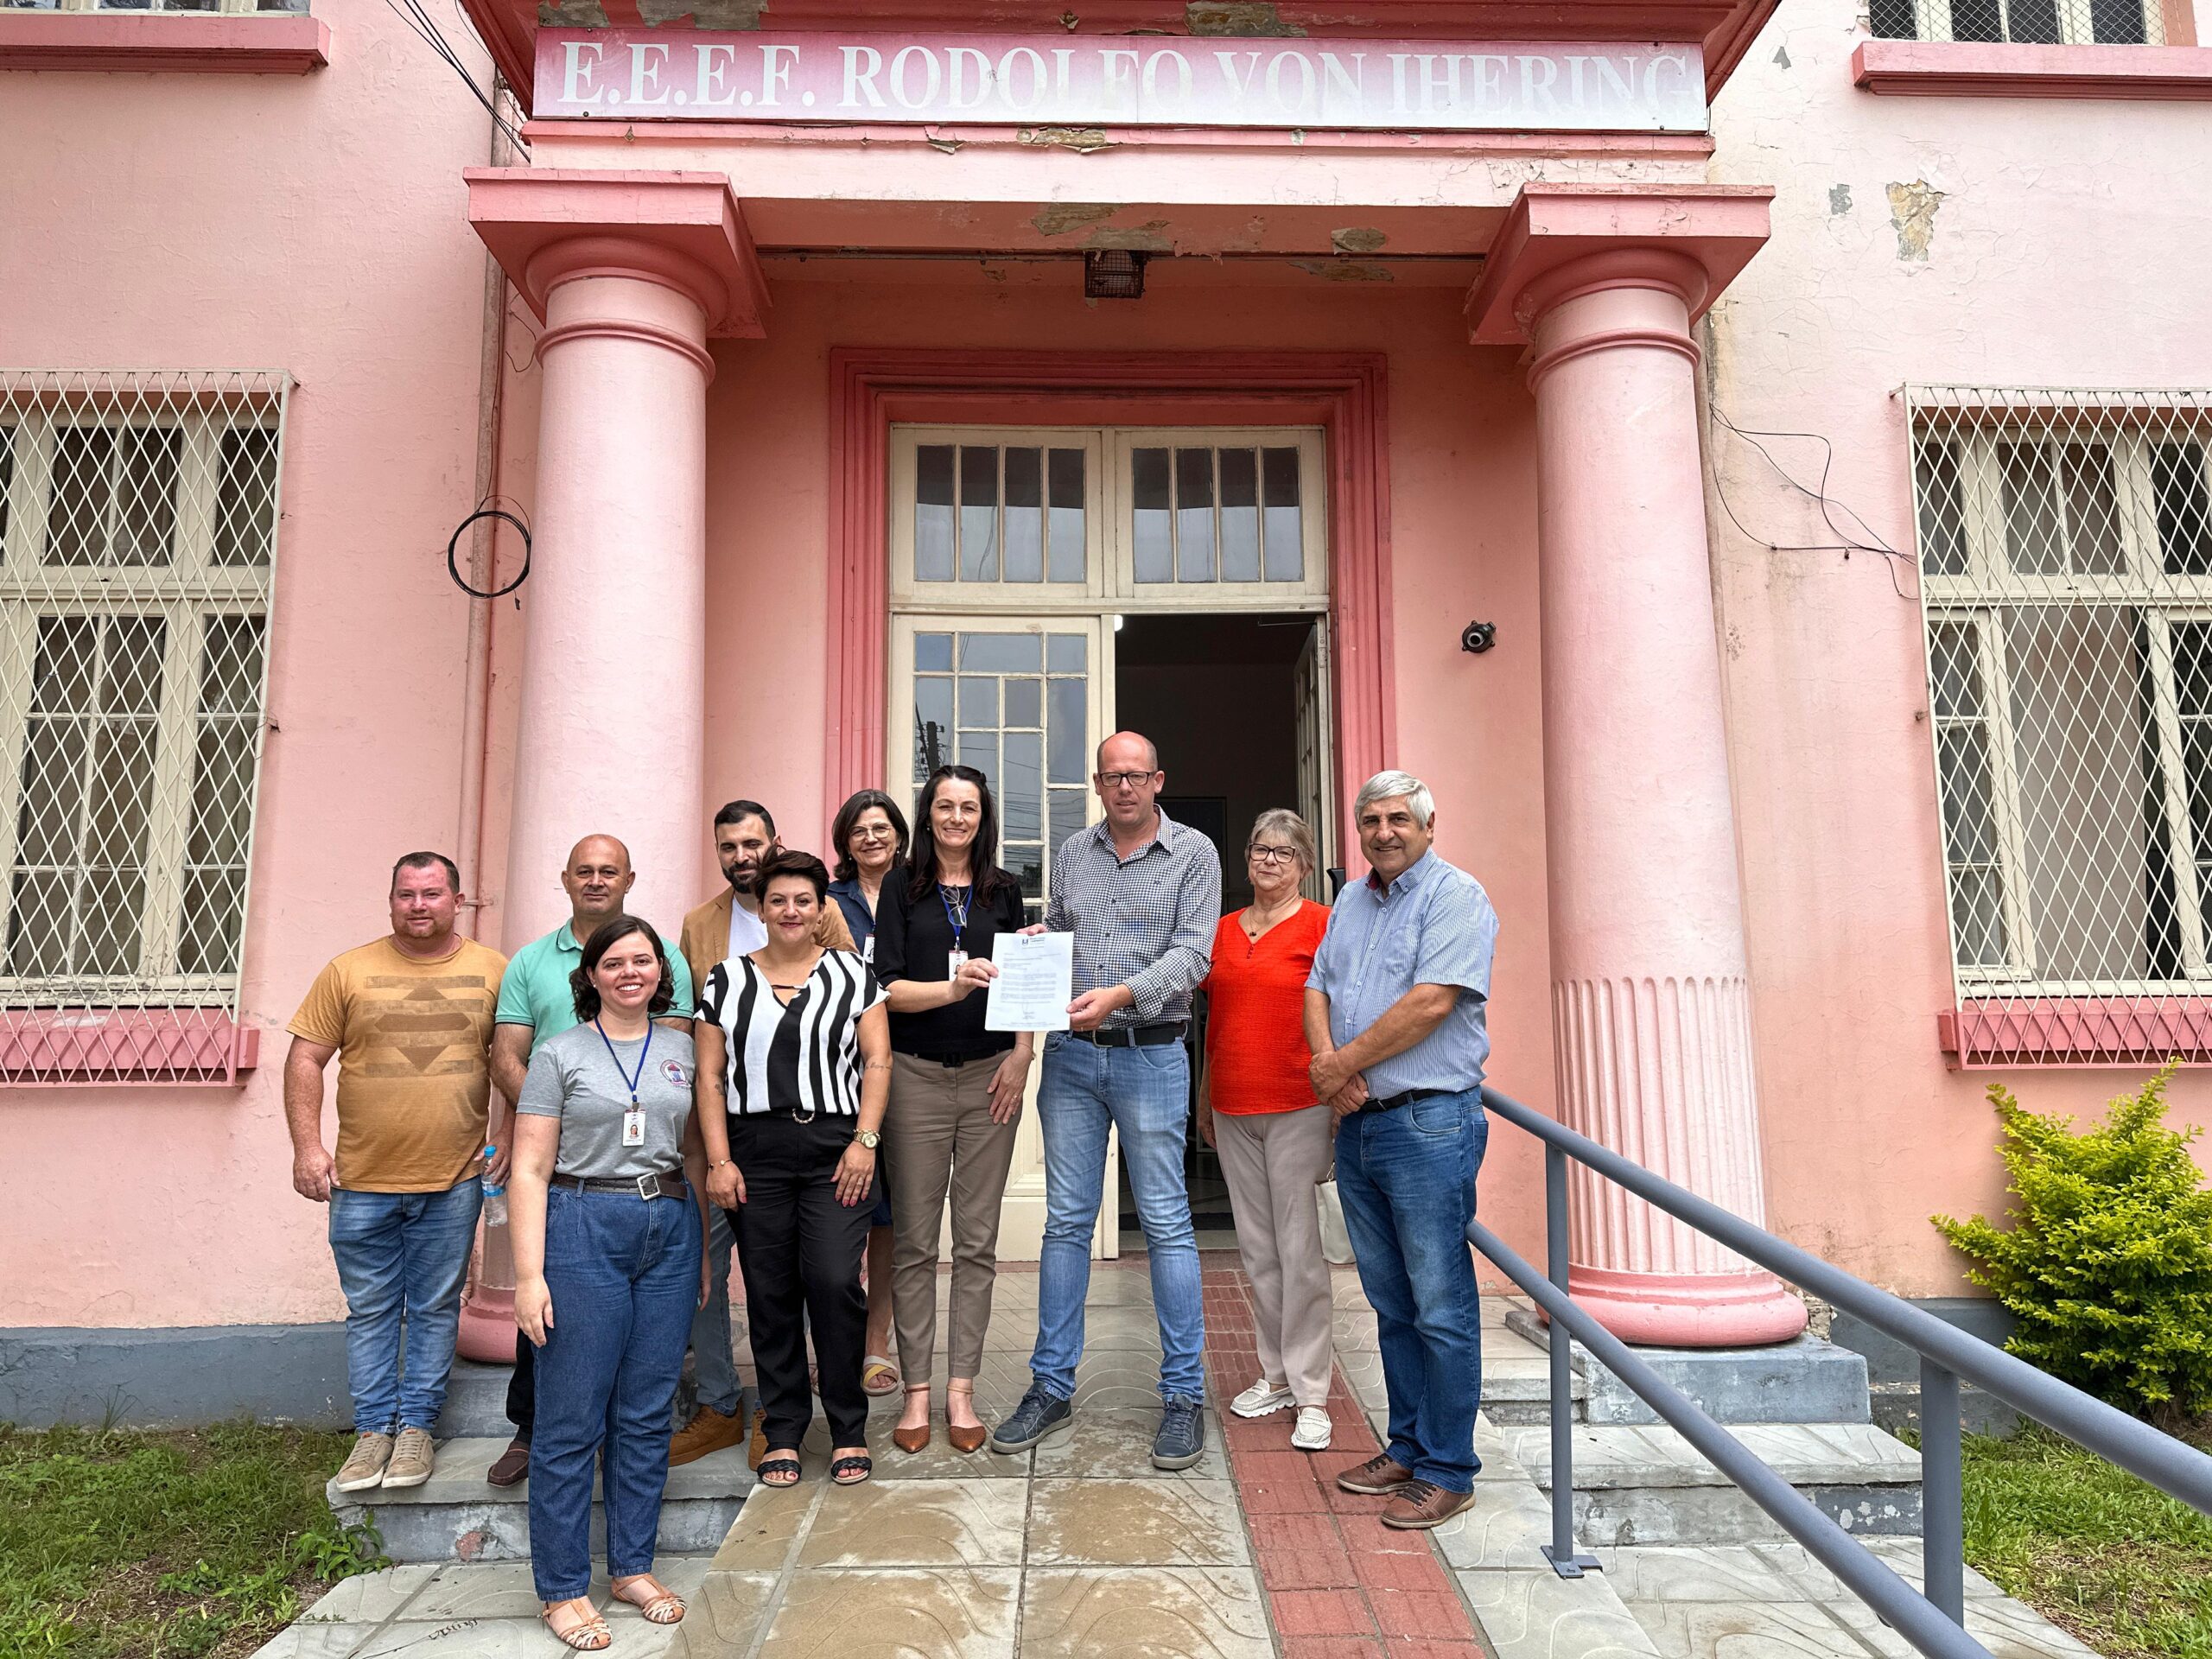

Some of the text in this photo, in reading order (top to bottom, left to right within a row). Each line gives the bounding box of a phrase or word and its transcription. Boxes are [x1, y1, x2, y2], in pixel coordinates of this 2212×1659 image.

[558, 41, 1691, 116] E.E.E.F. RODOLFO VON IHERING
